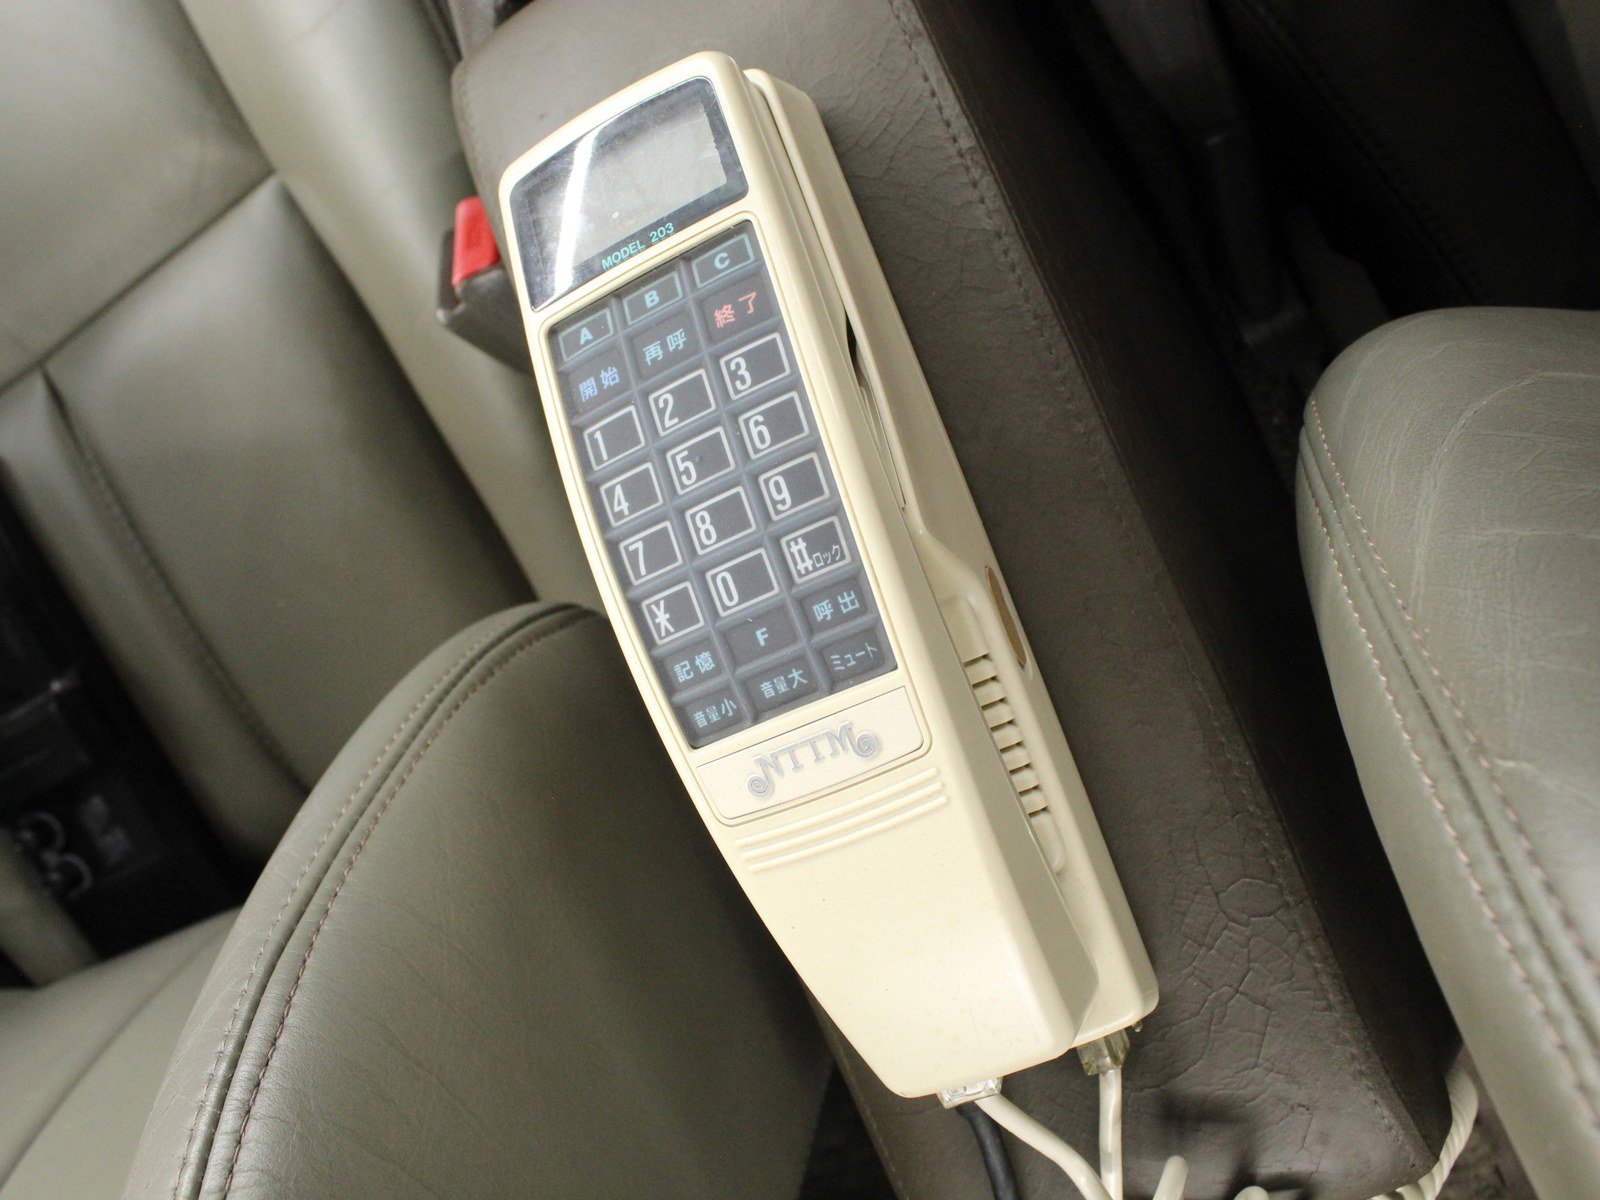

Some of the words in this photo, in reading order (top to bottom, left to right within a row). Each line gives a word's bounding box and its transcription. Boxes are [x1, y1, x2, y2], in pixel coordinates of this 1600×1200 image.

[601, 239, 645, 270] MODEL
[650, 222, 674, 243] 203
[714, 252, 730, 269] C
[645, 290, 660, 308] B
[714, 292, 757, 328] 終了
[579, 327, 593, 345] A
[643, 328, 687, 366] 再呼
[578, 366, 620, 402] 開始
[730, 357, 751, 391] 3
[658, 393, 679, 428] 2
[593, 430, 608, 461] 1
[749, 414, 771, 449] 6
[675, 450, 697, 485] 5
[613, 484, 630, 516] 4
[768, 475, 791, 511] 9
[695, 511, 717, 545] 8
[628, 540, 646, 576] 7
[812, 544, 841, 569] ロック
[716, 571, 740, 607] 0
[812, 590, 860, 622] 呼出
[755, 627, 769, 647] F
[674, 650, 716, 683] 記憶
[830, 641, 878, 671] ミュート
[759, 667, 808, 698] 音量大
[693, 698, 738, 728] 音量小
